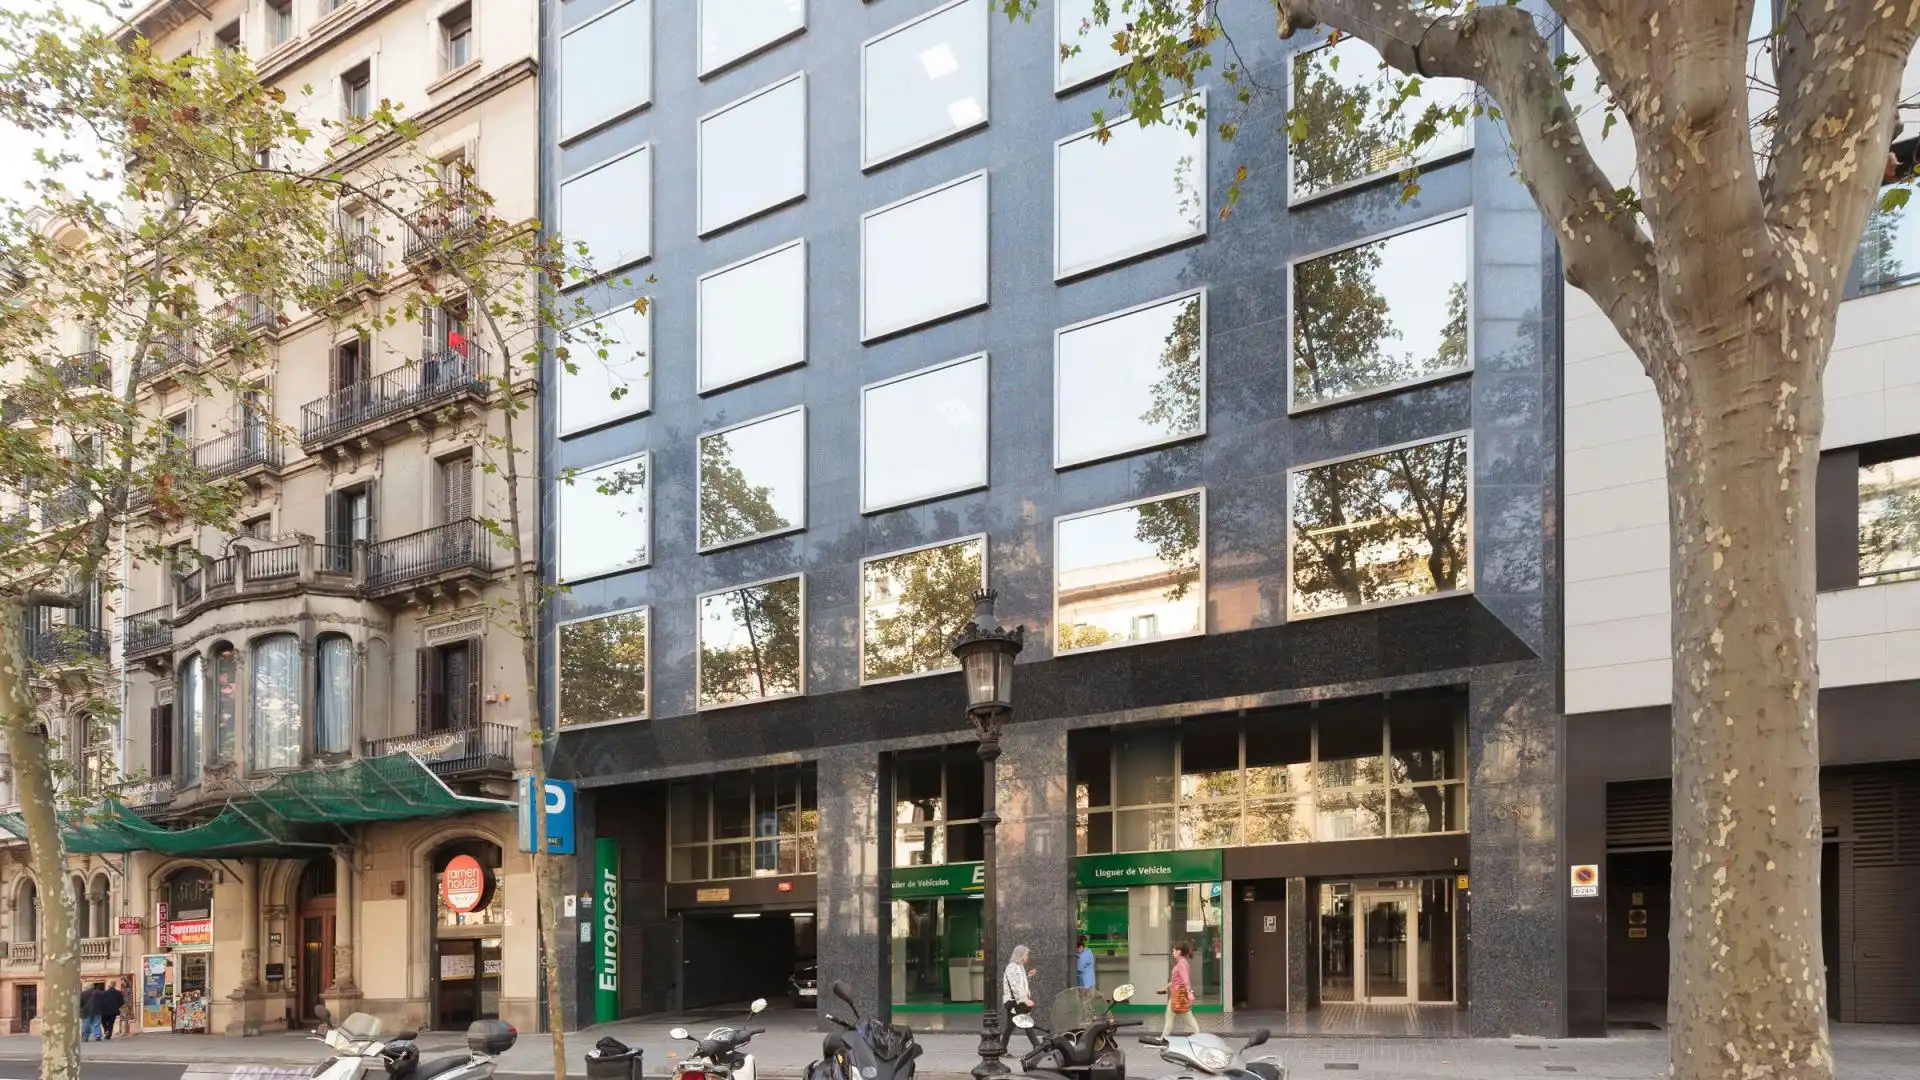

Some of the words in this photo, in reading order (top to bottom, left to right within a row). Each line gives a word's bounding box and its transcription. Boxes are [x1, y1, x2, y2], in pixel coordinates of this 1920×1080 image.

[447, 867, 480, 878] ramen
[1095, 869, 1123, 878] Lloguer
[1138, 866, 1172, 875] Vehicles
[447, 878, 478, 889] house
[891, 880, 905, 889] uiler
[119, 917, 139, 925] SUPER
[160, 904, 168, 945] SUPER
[599, 868, 618, 992] Europcar
